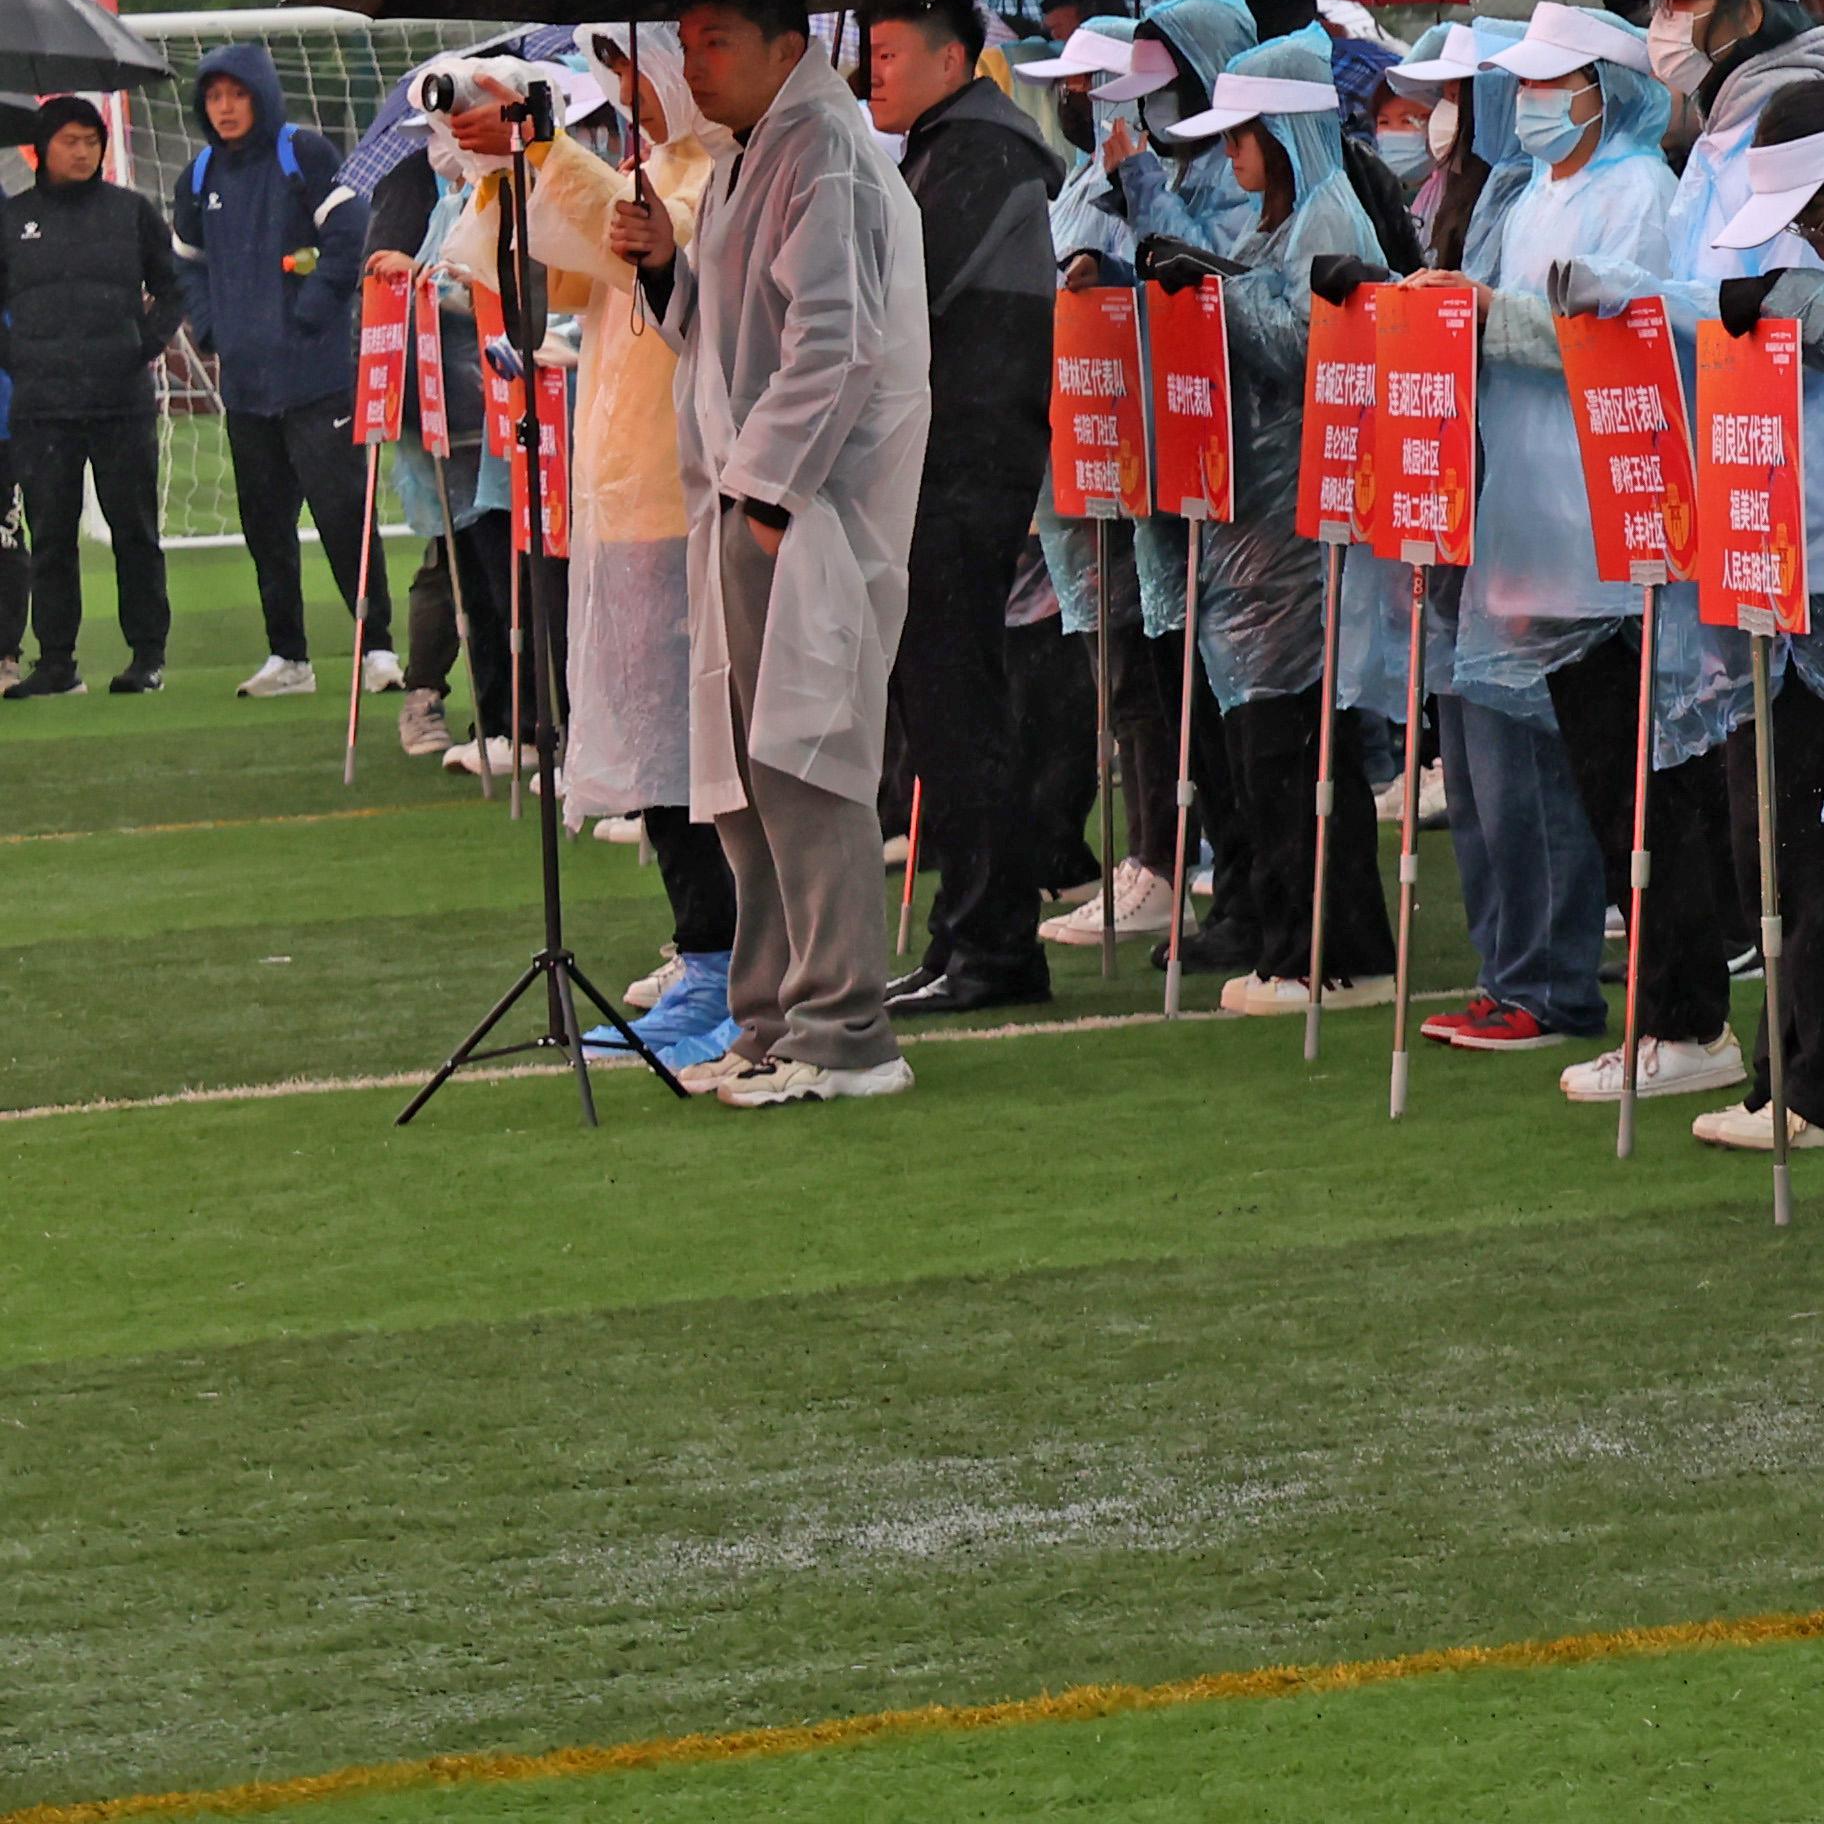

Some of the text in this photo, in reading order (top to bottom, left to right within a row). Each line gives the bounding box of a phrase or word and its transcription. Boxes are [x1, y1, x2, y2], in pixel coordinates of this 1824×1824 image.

[1057, 357, 1124, 395] 碑林区代表队
[1315, 361, 1376, 406] 新城区代表队
[1388, 371, 1457, 418] 莲湖区代表队
[1584, 384, 1668, 434] 灞桥区代表队
[1712, 413, 1785, 467] 阎良区代表队
[1392, 491, 1449, 532] 劳动二坊社区
[1624, 511, 1667, 550] 永丰社区
[1722, 549, 1783, 597] 人民东路社区
